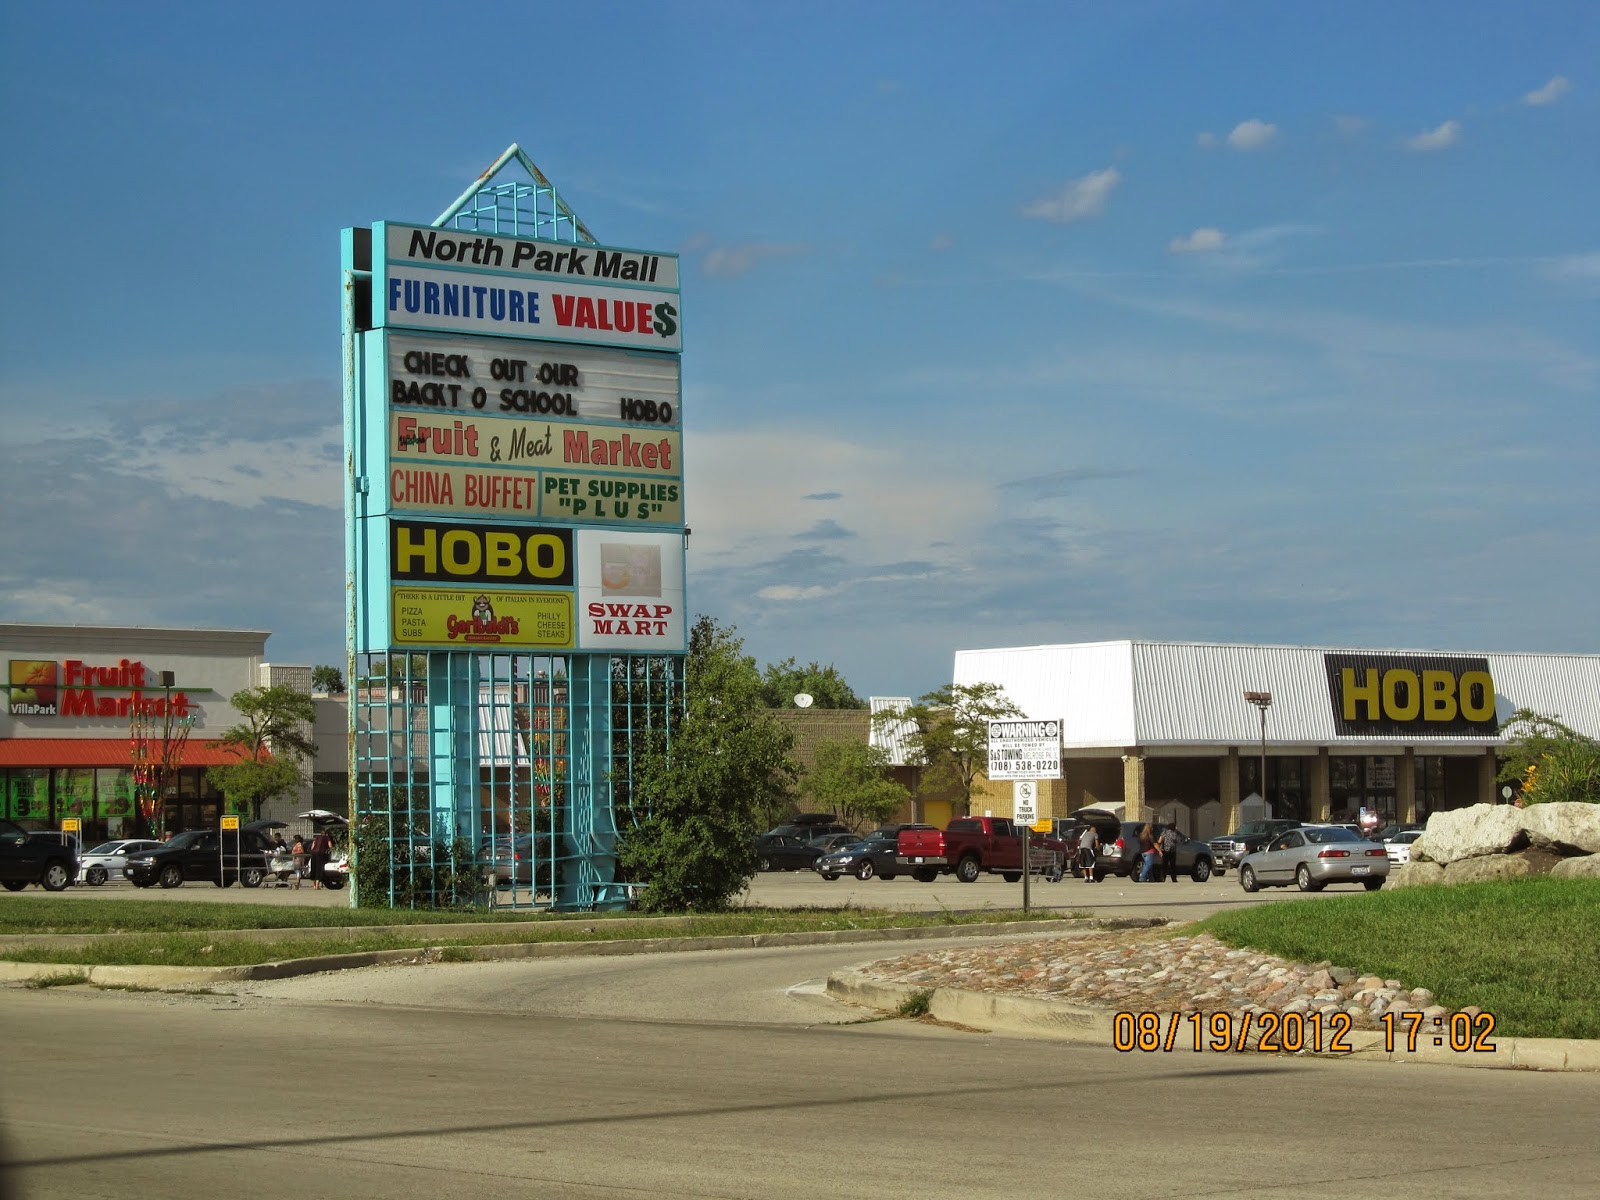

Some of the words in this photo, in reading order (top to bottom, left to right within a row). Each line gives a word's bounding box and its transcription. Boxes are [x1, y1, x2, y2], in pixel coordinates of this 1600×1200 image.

[408, 230, 504, 266] North
[512, 241, 588, 275] Park
[593, 250, 659, 282] Mall
[389, 278, 540, 323] FURNITURE
[552, 293, 677, 338] VALUE$
[404, 350, 471, 378] CHECK
[490, 358, 528, 382] OUT
[539, 363, 579, 386] OUR
[499, 388, 577, 416] SCHOOL
[620, 397, 673, 423] HOBO
[397, 416, 479, 457] Fruit
[490, 436, 502, 462] &
[508, 425, 553, 462] Meat
[563, 430, 672, 470] Market
[391, 469, 454, 506] CHINA
[465, 474, 536, 510] BUFFET
[545, 477, 581, 495] PET
[588, 480, 679, 502] SUPPLIES
[397, 527, 565, 578] HOBO
[401, 607, 423, 615] PIZZA
[537, 612, 561, 620] PHILLY
[588, 602, 673, 619] SWAP
[401, 618, 427, 627] PASTA
[537, 621, 566, 629] CHEESE
[592, 620, 669, 636] MART
[402, 629, 423, 637] SUBS
[537, 630, 565, 638] STEAKS
[63, 658, 145, 687] Fruit
[1342, 667, 1496, 722] HOBO
[1001, 722, 1046, 738] WARNING
[1001, 748, 1022, 760] TOWING
[991, 761, 1012, 771] (708)
[1015, 760, 1058, 771] 538-0220
